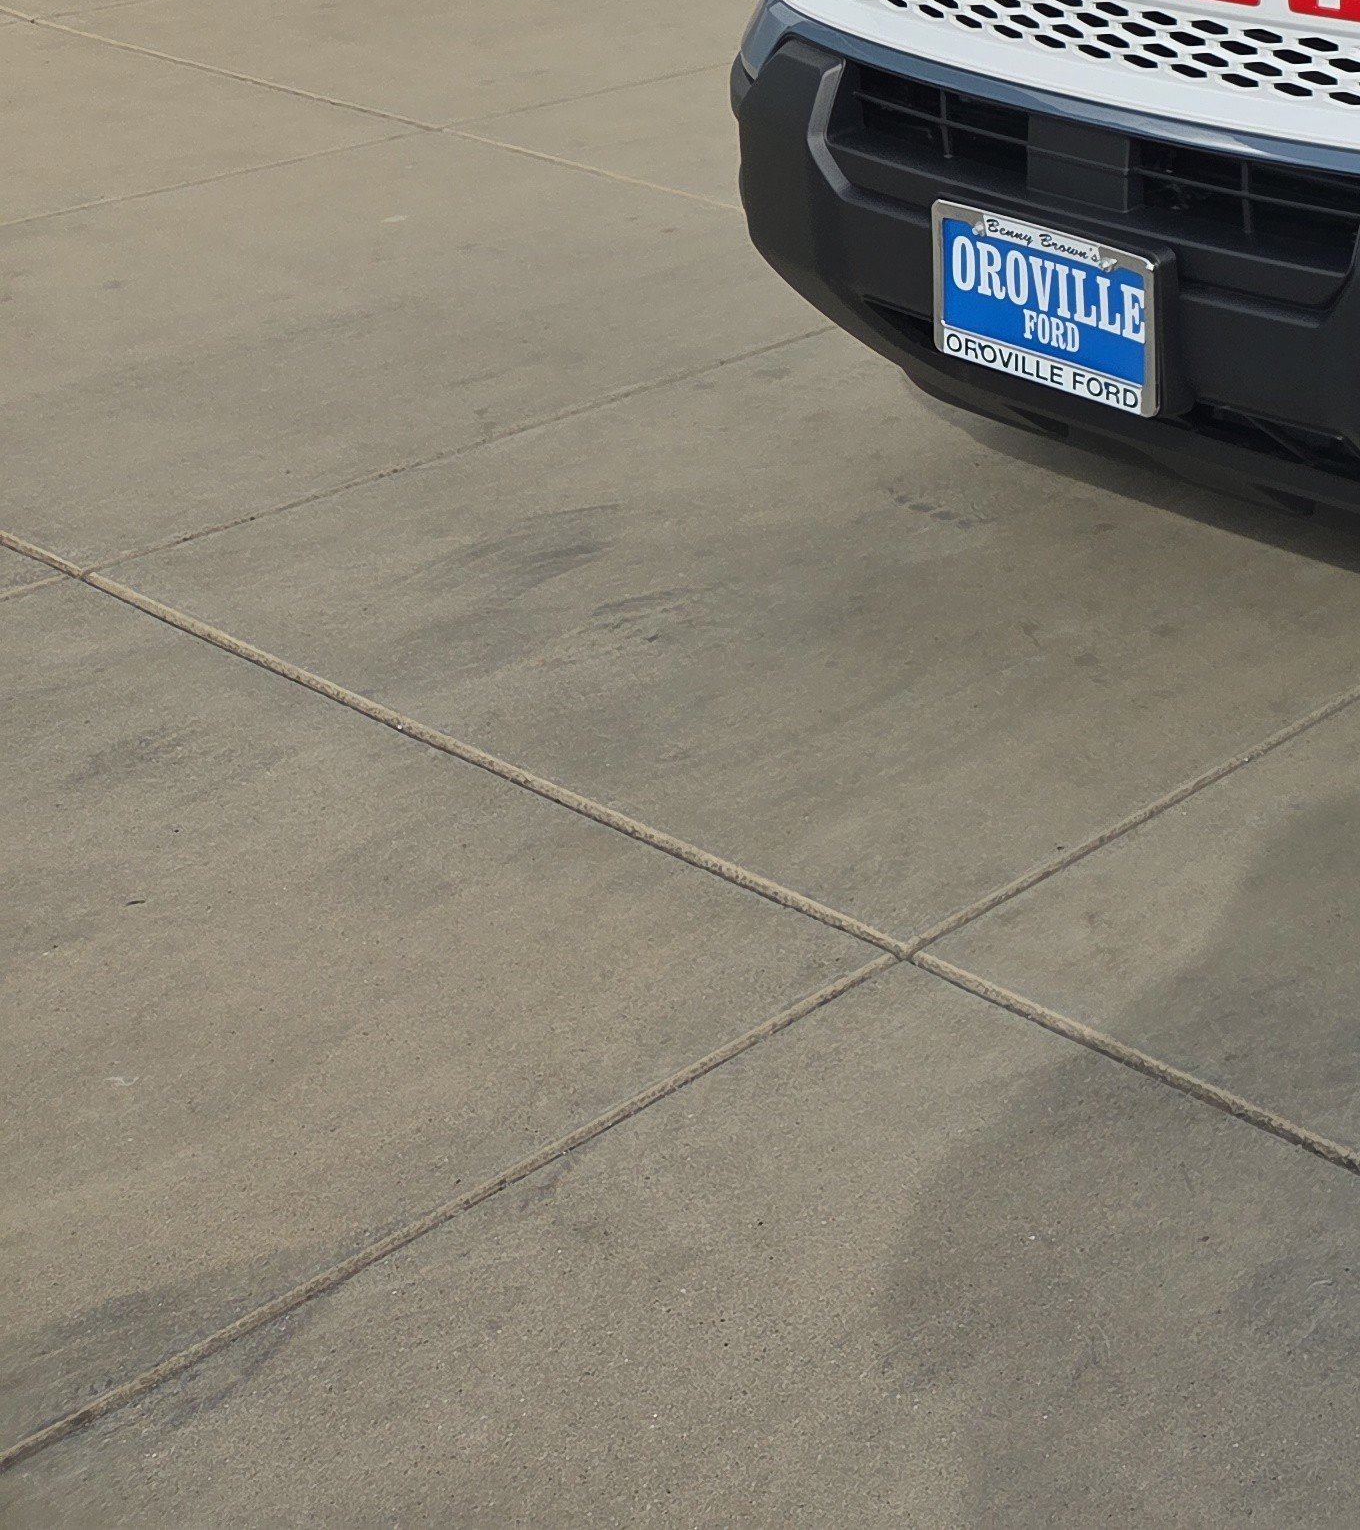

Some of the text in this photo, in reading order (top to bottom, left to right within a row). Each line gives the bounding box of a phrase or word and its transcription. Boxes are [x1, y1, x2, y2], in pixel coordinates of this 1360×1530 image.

[986, 218, 1101, 262] Benny Brown's
[951, 235, 1146, 345] OROVILLE
[1023, 308, 1080, 353] FORD
[946, 334, 1139, 410] OROVILLE FORD
